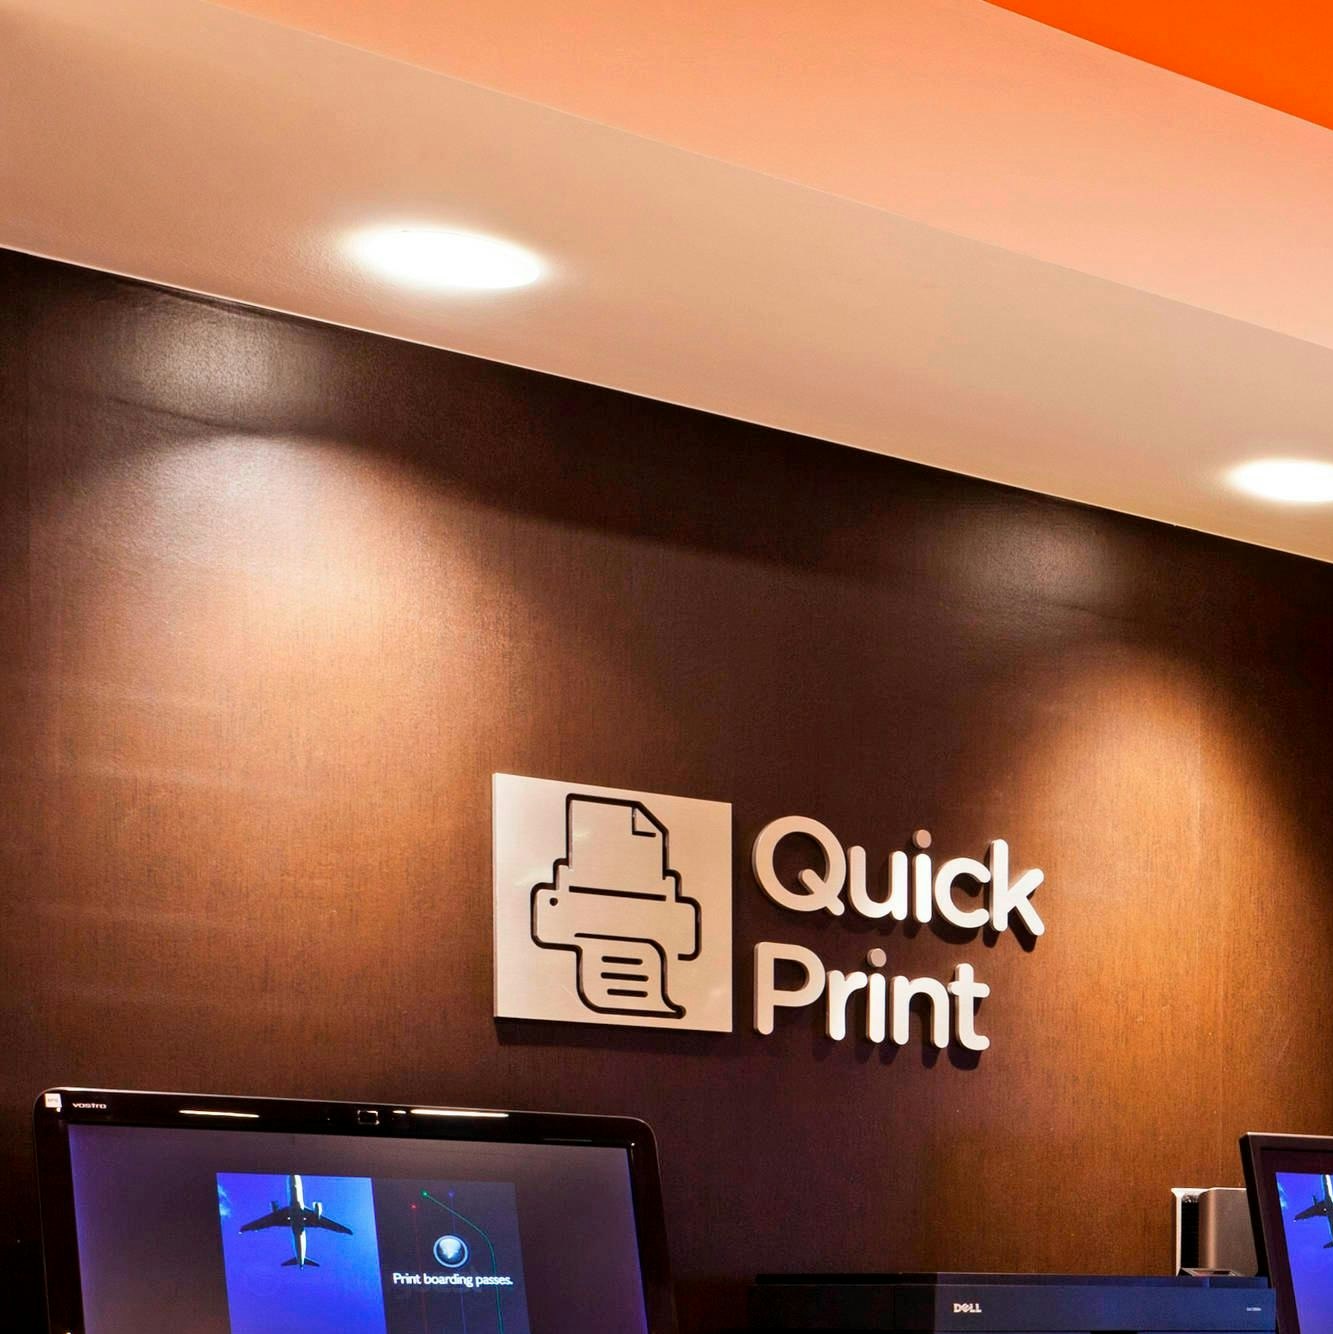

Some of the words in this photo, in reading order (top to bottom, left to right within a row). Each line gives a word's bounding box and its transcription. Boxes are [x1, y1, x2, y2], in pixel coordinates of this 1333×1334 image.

[752, 815, 1045, 937] Quick
[753, 942, 990, 1051] Print
[393, 1273, 421, 1285] Print
[423, 1273, 474, 1287] boarding
[475, 1276, 513, 1287] passes.
[953, 1303, 982, 1313] DELL
